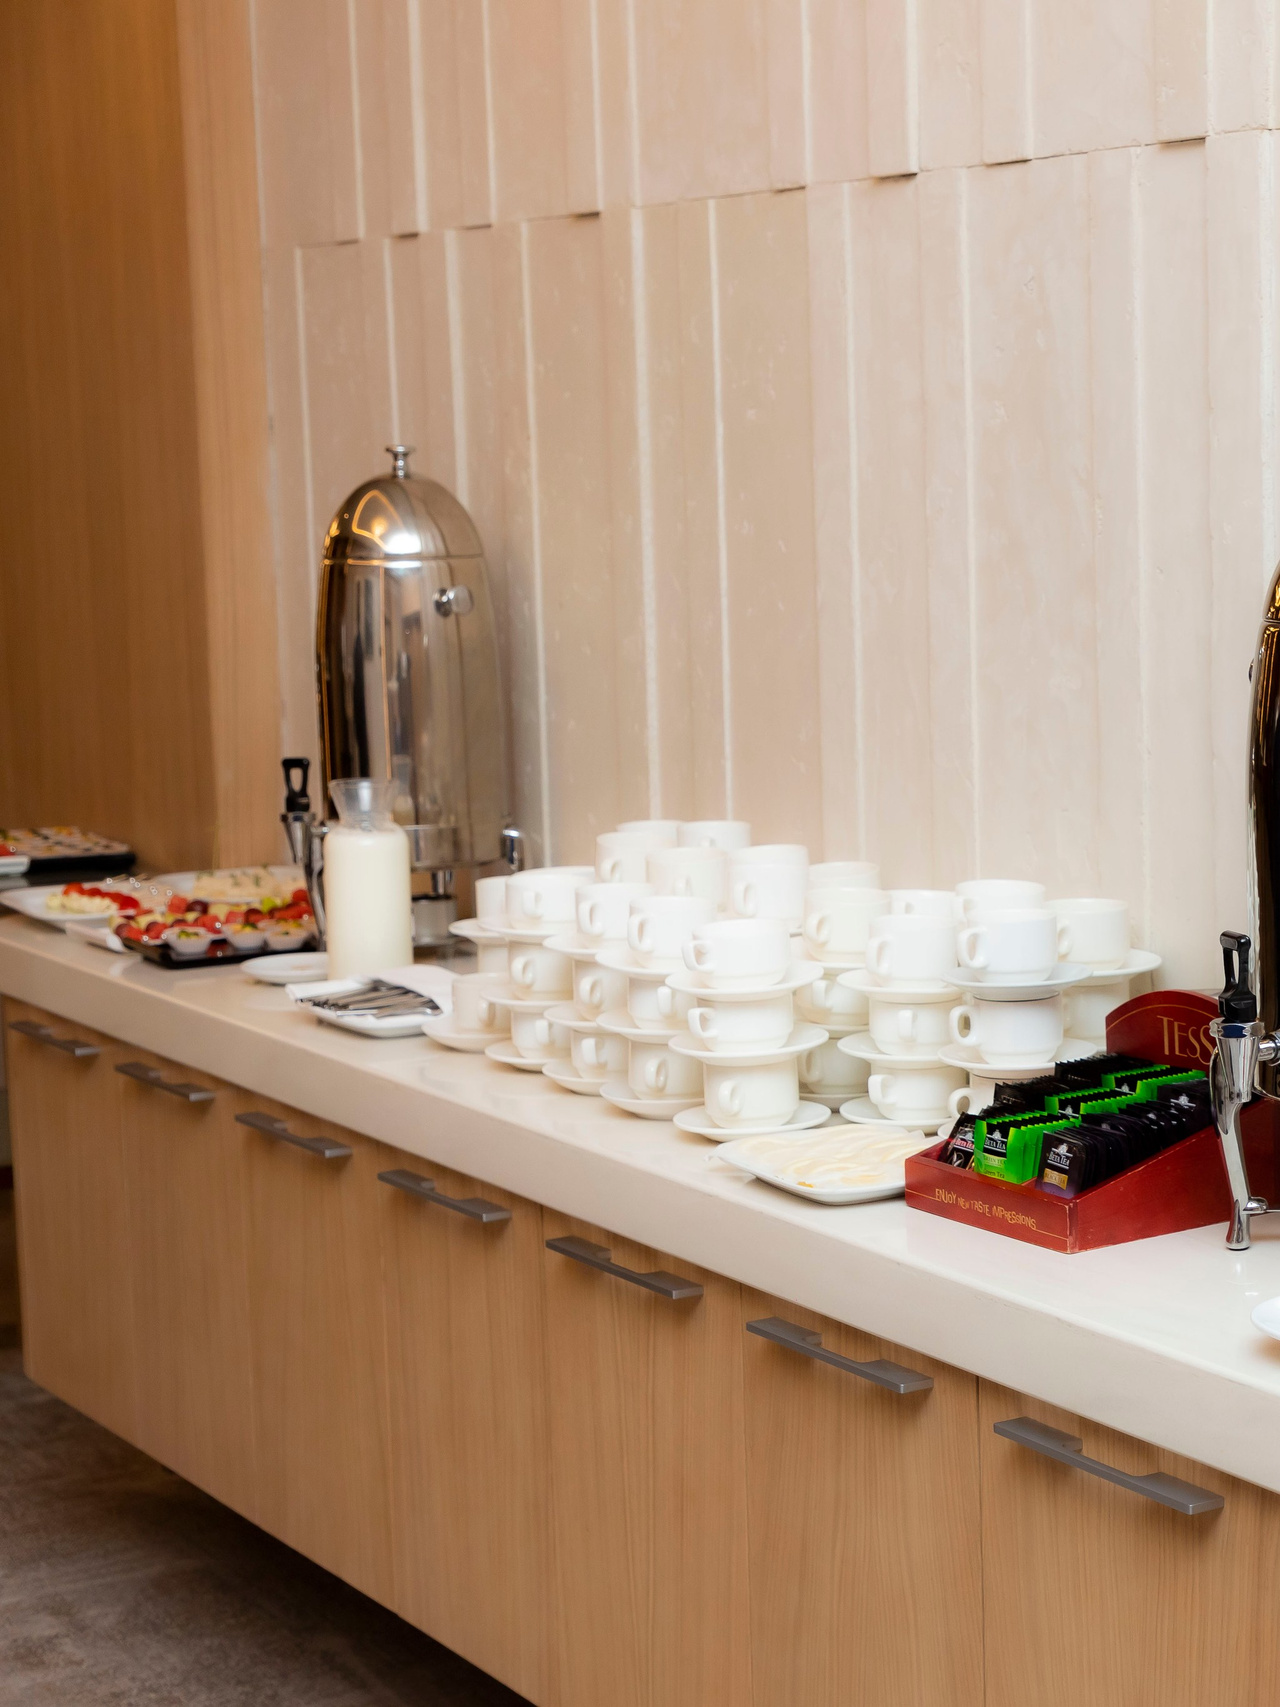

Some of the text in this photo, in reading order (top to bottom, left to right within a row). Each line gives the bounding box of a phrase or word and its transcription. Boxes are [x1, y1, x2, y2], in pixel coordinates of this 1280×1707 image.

[985, 1138, 1006, 1150] BETA TEA
[1049, 1152, 1070, 1166] BETA TEA
[970, 1200, 991, 1217] TASTE
